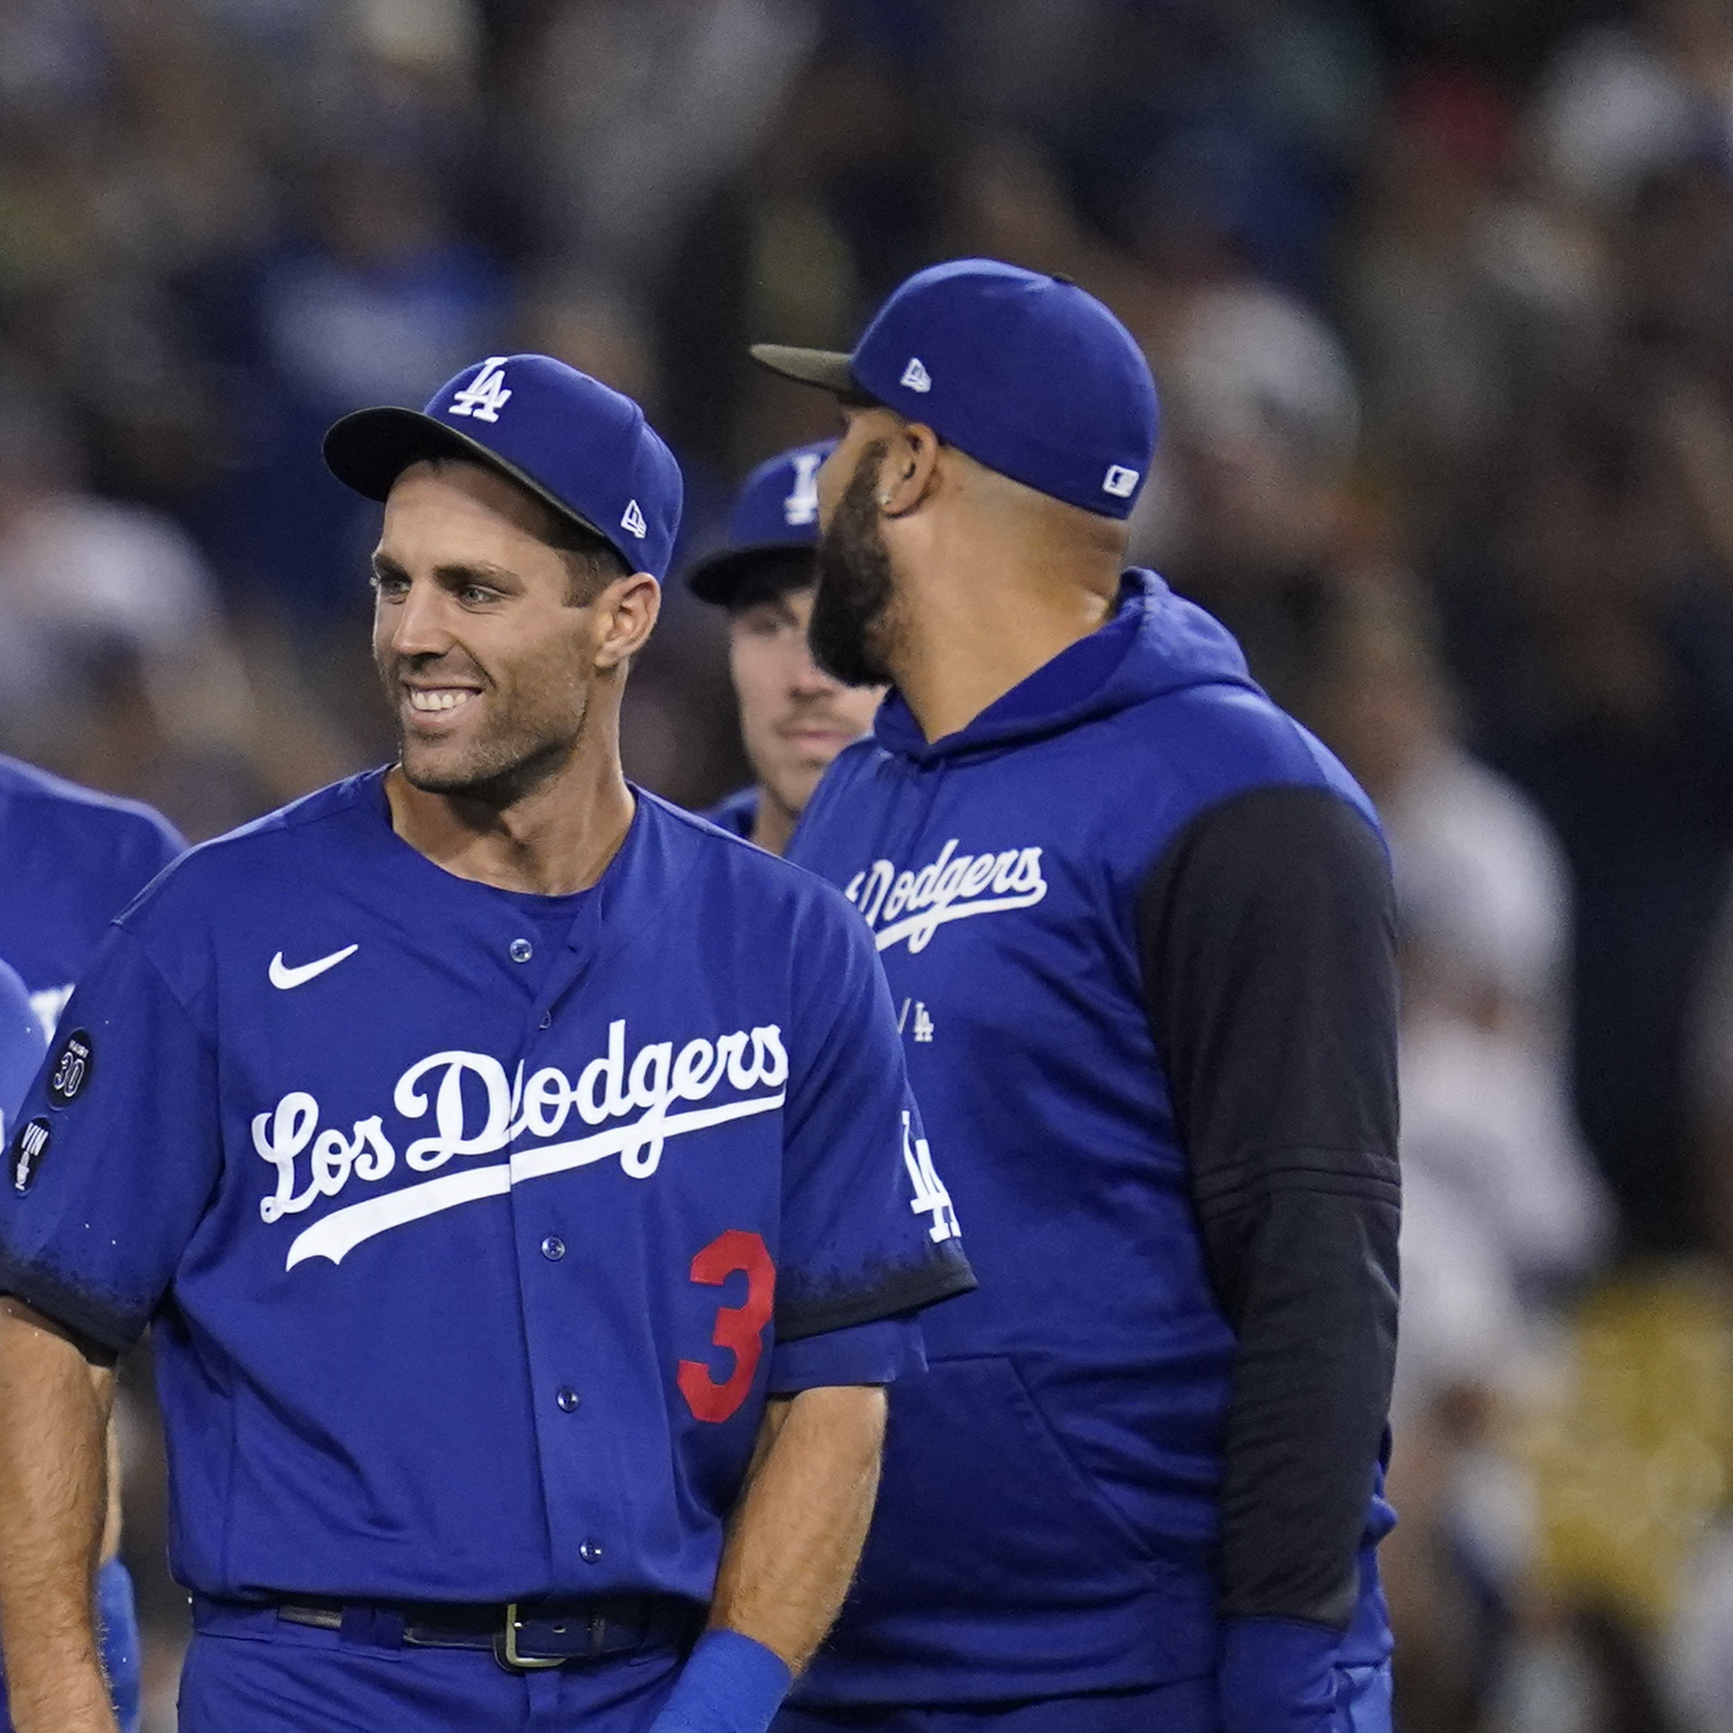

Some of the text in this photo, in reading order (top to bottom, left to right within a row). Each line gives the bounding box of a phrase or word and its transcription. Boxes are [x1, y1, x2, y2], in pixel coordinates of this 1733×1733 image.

[448, 356, 512, 423] LA
[845, 838, 1048, 955] Dodgers
[913, 1001, 934, 1042] LA
[53, 1051, 85, 1097] 30
[21, 1121, 50, 1157] VIN
[251, 1018, 790, 1223] Los Dodgers
[677, 1229, 777, 1424] 3
